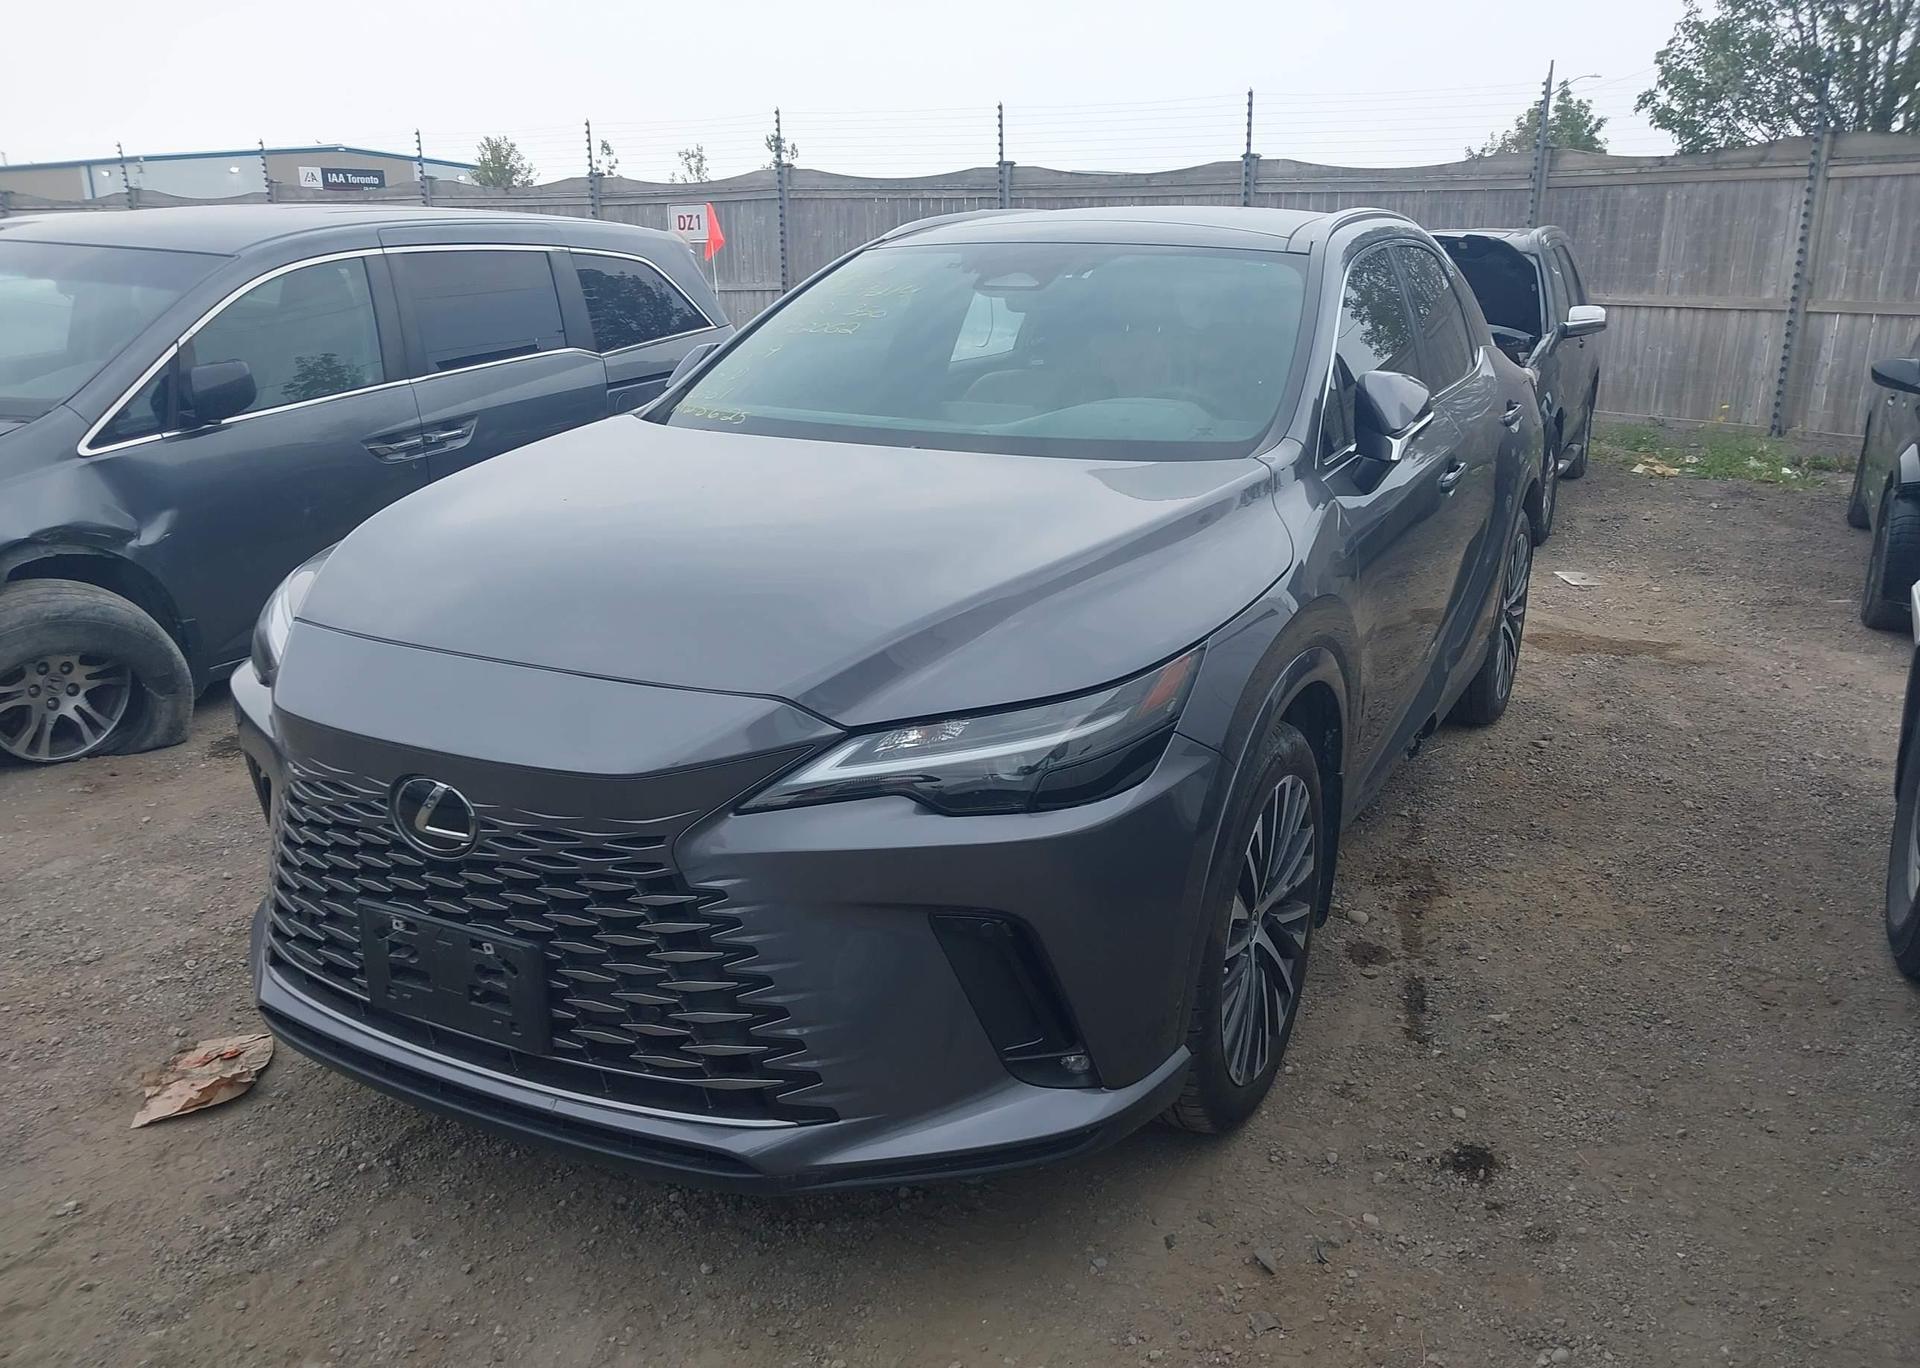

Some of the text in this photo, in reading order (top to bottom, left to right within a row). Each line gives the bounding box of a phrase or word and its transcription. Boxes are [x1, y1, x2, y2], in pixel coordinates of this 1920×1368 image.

[327, 172, 379, 185] IAA Toronto
[677, 214, 701, 231] DZ1
